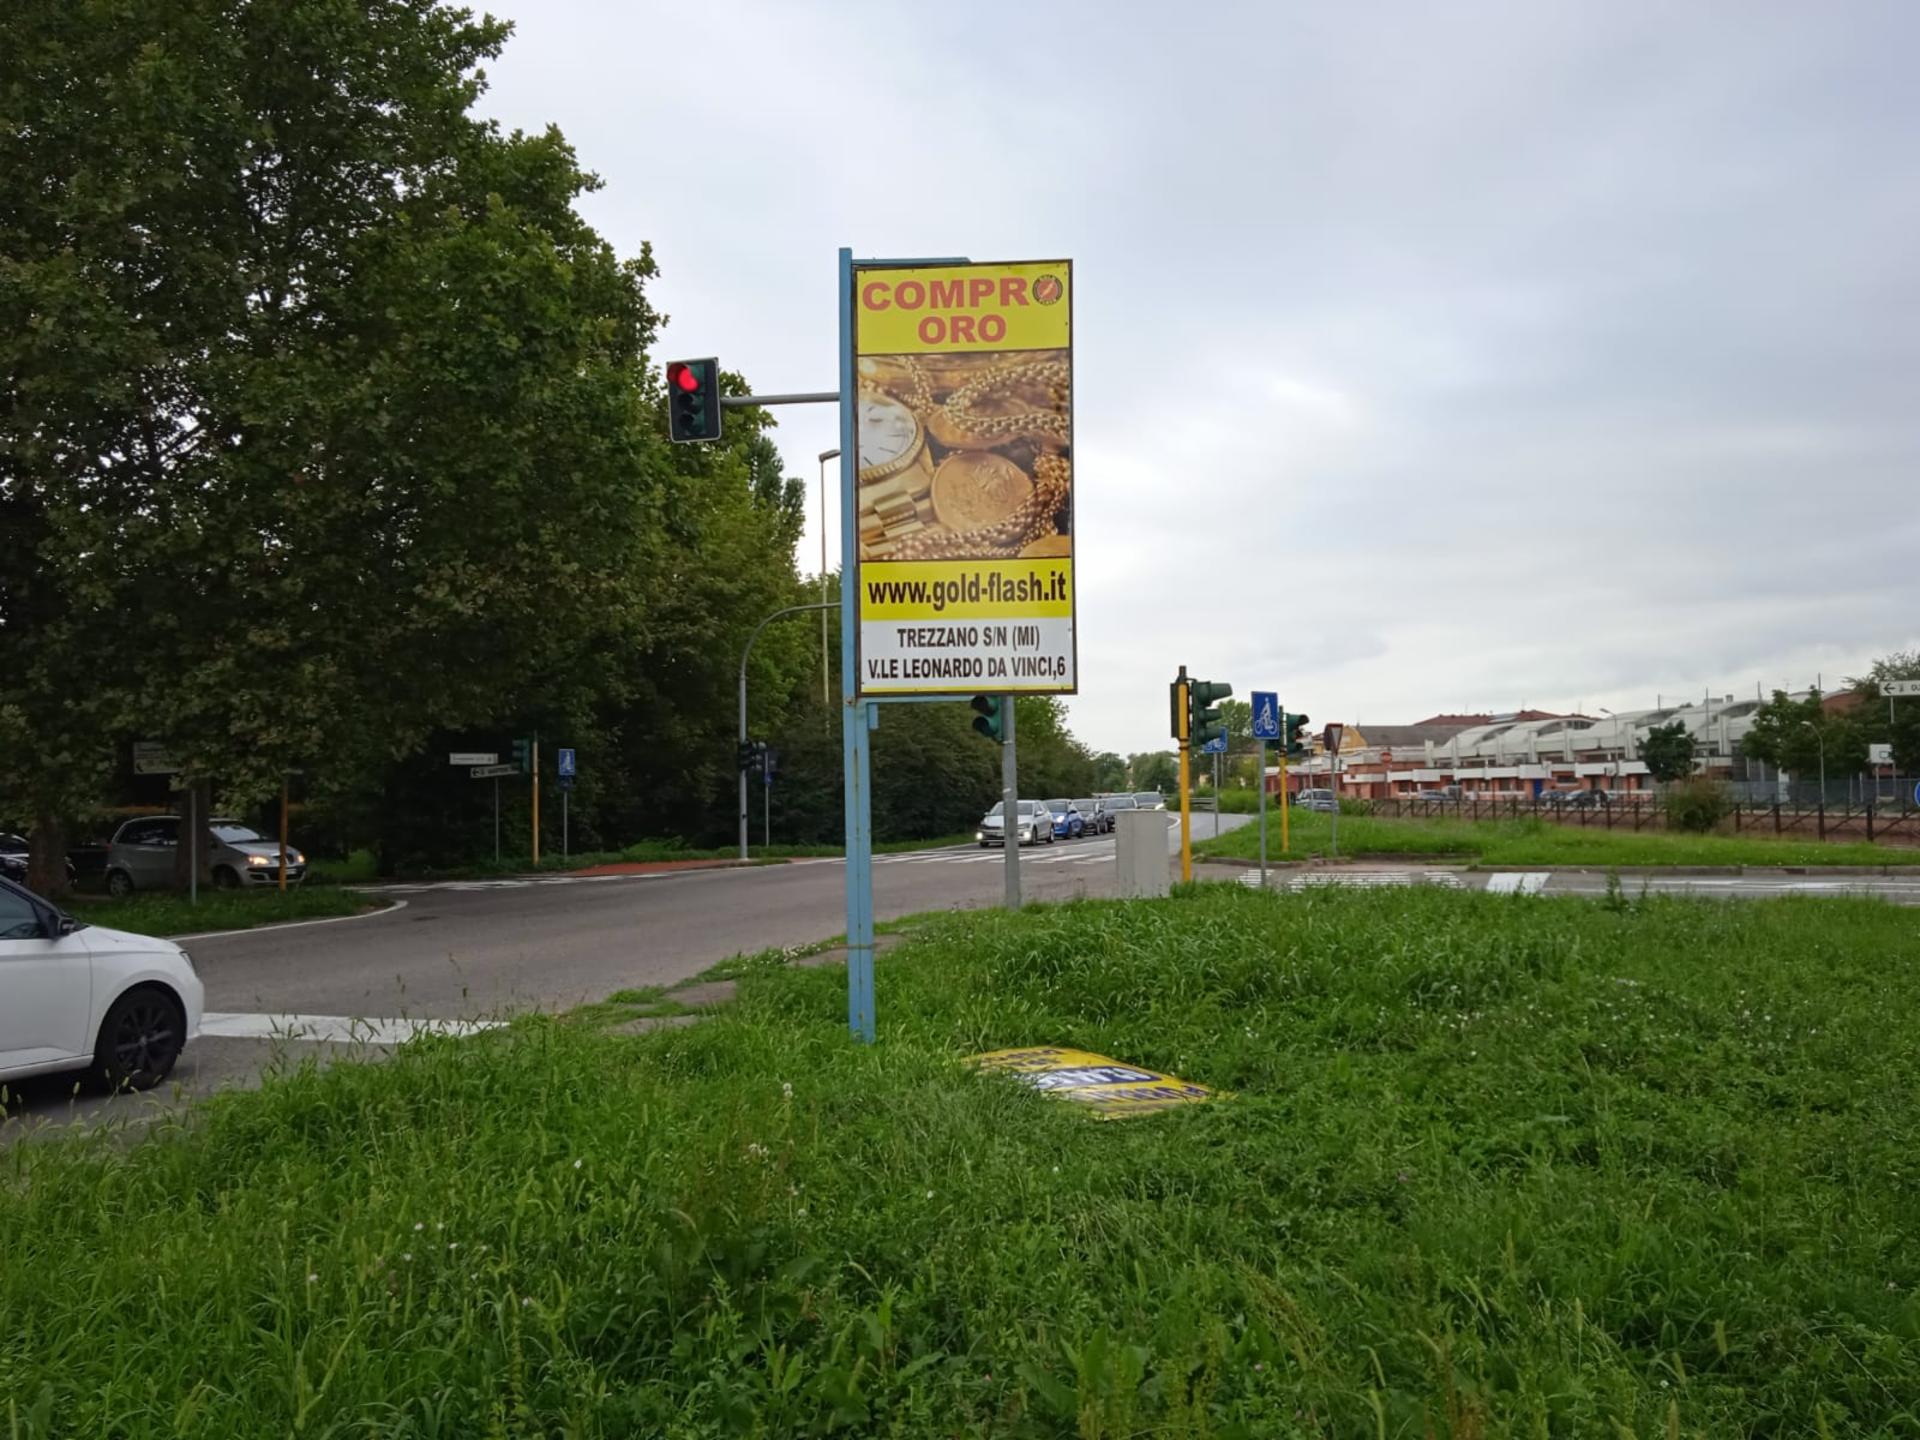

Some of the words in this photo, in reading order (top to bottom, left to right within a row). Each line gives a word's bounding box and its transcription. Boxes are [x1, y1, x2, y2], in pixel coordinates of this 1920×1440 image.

[918, 315, 1006, 344] ORO
[868, 571, 1066, 611] www.gold-flash.it
[897, 628, 978, 648] TREZZANO
[983, 627, 1007, 647] S/N
[1012, 625, 1040, 651] (MI)
[868, 659, 898, 679] V.LE
[903, 658, 982, 678] LEONARDO
[988, 657, 1007, 677] DA
